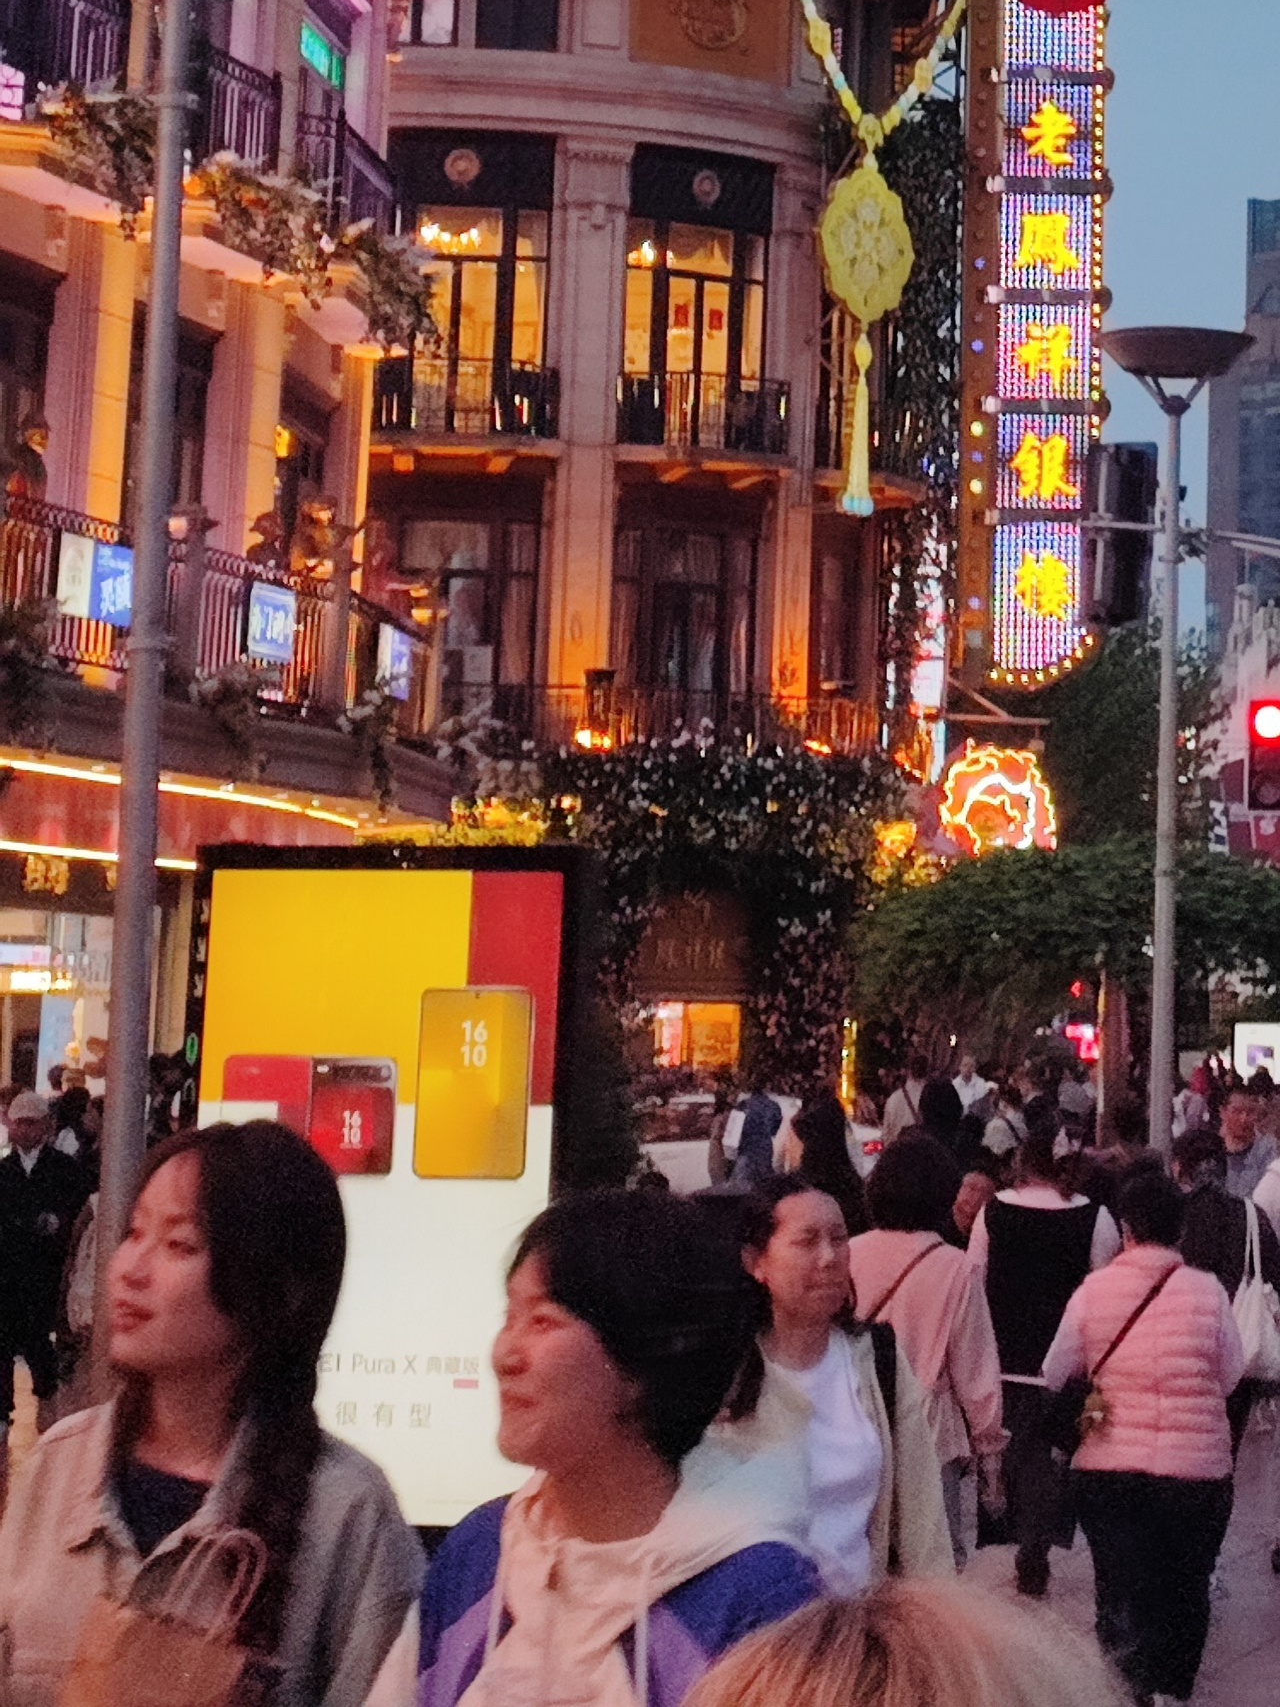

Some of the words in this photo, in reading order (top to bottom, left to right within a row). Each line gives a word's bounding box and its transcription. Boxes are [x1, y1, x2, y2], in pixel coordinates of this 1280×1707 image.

[461, 1019, 489, 1044] 16
[460, 1044, 488, 1068] 10
[352, 1353, 396, 1375] Pura
[403, 1354, 418, 1375] X
